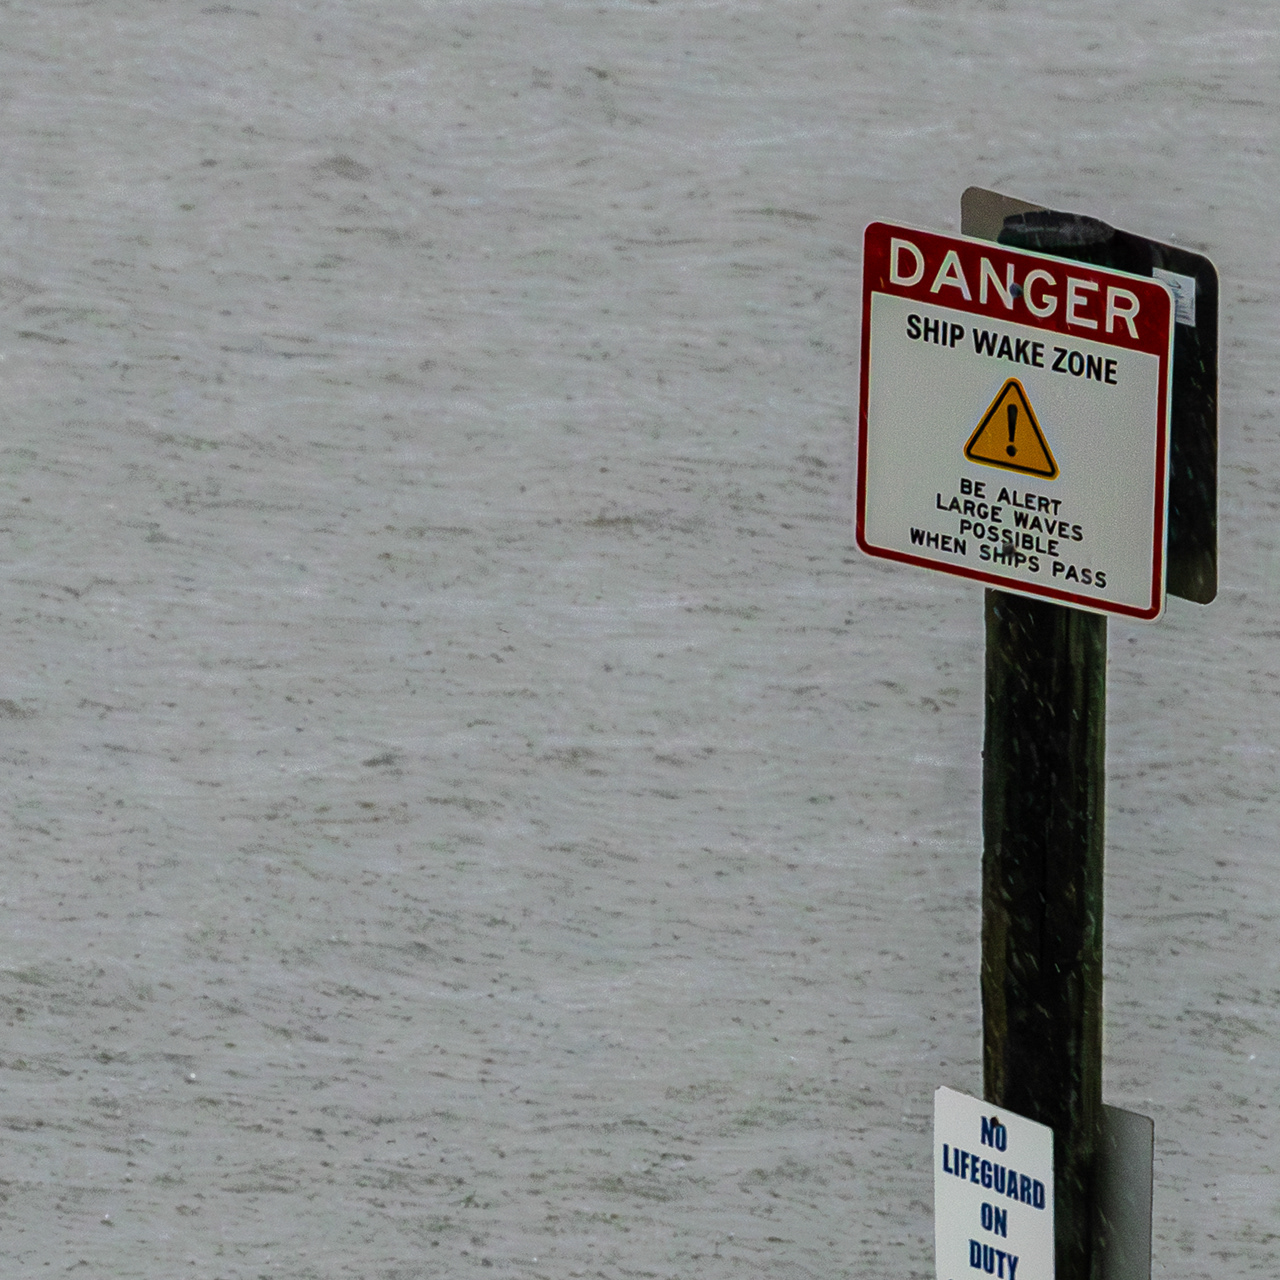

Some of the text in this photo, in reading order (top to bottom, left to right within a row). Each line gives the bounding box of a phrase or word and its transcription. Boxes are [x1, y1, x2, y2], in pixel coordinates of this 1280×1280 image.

[890, 237, 1140, 339] DANGER
[906, 313, 1118, 386] SHIP WAKE ZONE
[936, 492, 1084, 542] LARGE WAVES
[960, 477, 1063, 516] BE ALERT
[910, 527, 1107, 589] WHEN SHIPS PASS
[959, 518, 1060, 558] POSSIBLE
[980, 1115, 1008, 1153] NO
[942, 1143, 1046, 1211] LIFEGUARD
[980, 1202, 1008, 1239] ON
